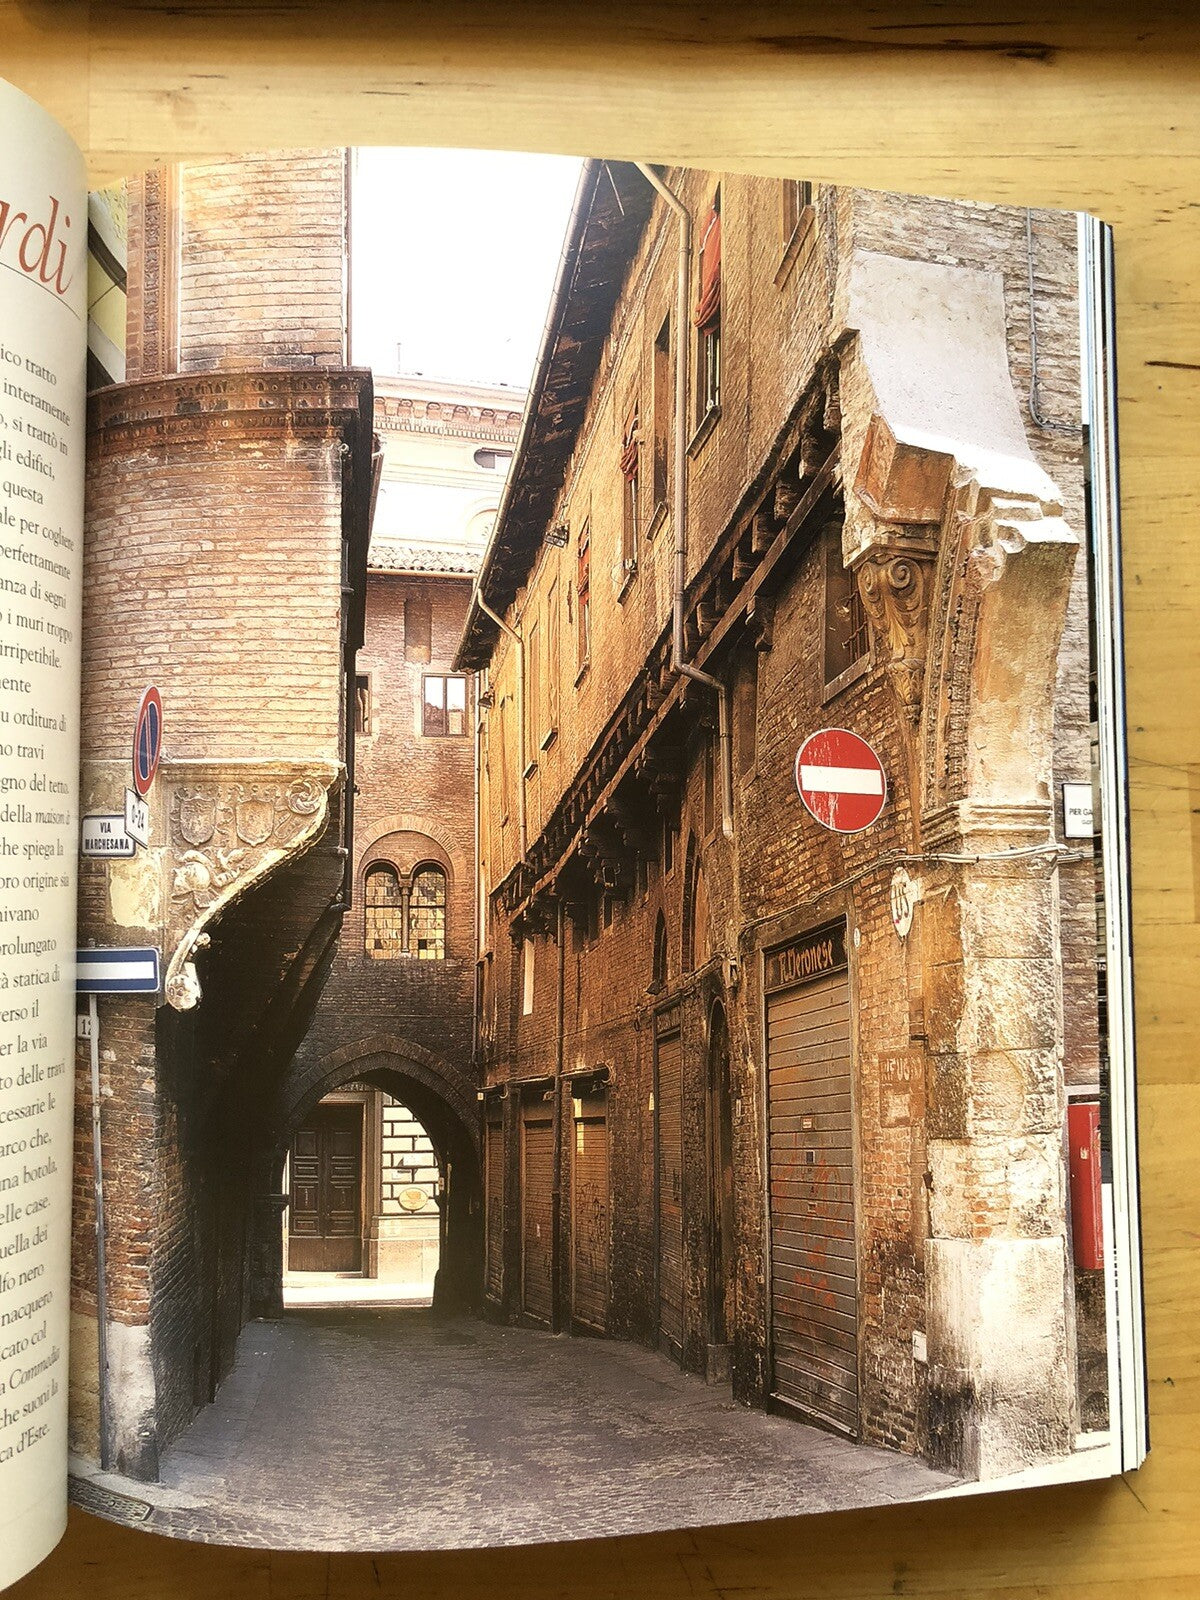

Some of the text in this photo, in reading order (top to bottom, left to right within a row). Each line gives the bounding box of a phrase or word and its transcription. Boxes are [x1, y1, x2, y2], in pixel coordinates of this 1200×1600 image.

[1, 343, 57, 386] ico tratto
[4, 377, 71, 427] interamente
[12, 416, 23, 432] si
[27, 423, 58, 449] trattò
[0, 440, 55, 481] li edifici,
[3, 480, 44, 505] questa
[20, 518, 40, 534] per
[42, 526, 74, 552] cogliere
[30, 580, 41, 600] di
[44, 590, 67, 610] segni
[16, 614, 44, 632] muri
[47, 622, 74, 645] troppo
[0, 677, 32, 694] ente
[13, 707, 57, 731] orditura
[58, 713, 67, 733] di
[17, 744, 44, 760] travi
[0, 776, 27, 794] gno
[29, 772, 46, 793] del
[0, 803, 32, 824] della
[100, 822, 111, 833] VIA
[0, 836, 64, 861] he spiega la
[85, 839, 129, 850] MARCHESANA
[22, 872, 59, 893] origine
[0, 905, 39, 922] ivano
[0, 935, 57, 957] rolungato
[13, 969, 51, 989] statica
[52, 963, 60, 982] di
[0, 998, 39, 1023] erso il
[17, 1034, 28, 1054] la
[32, 1033, 48, 1050] via
[17, 1066, 44, 1087] delle
[48, 1092, 56, 1111] le
[0, 1174, 19, 1193] na
[25, 1196, 51, 1216] case.
[32, 1225, 48, 1246] dei
[19, 1263, 45, 1286] nero
[1, 1290, 53, 1327] nacquero
[31, 1320, 47, 1345] col
[22, 1384, 50, 1418] suoni
[16, 1423, 50, 1454] d'Este.
